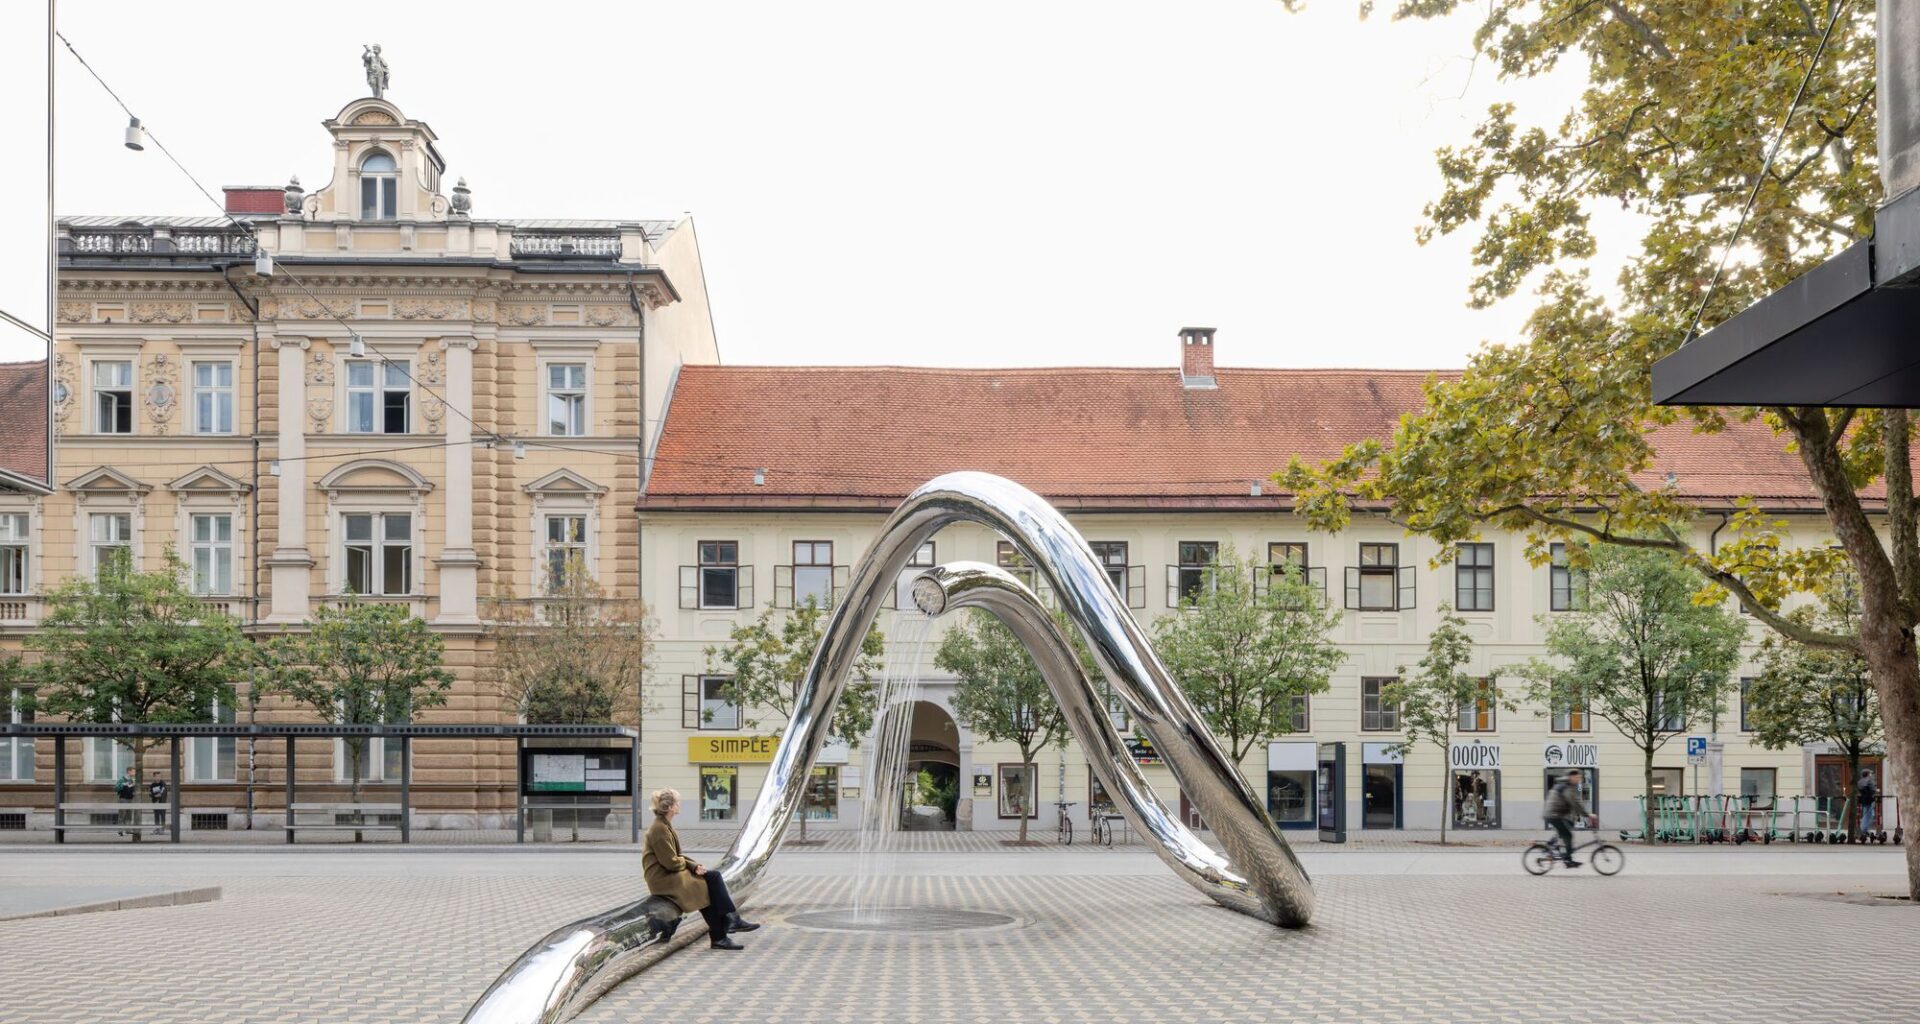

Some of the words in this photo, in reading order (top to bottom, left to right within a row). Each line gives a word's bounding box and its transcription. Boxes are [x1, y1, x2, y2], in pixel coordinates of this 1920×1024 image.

[710, 739, 770, 753] SIMPLE
[1689, 739, 1700, 752] P
[1452, 745, 1500, 767] OOOPS!
[1566, 744, 1598, 766] OOOPS!
